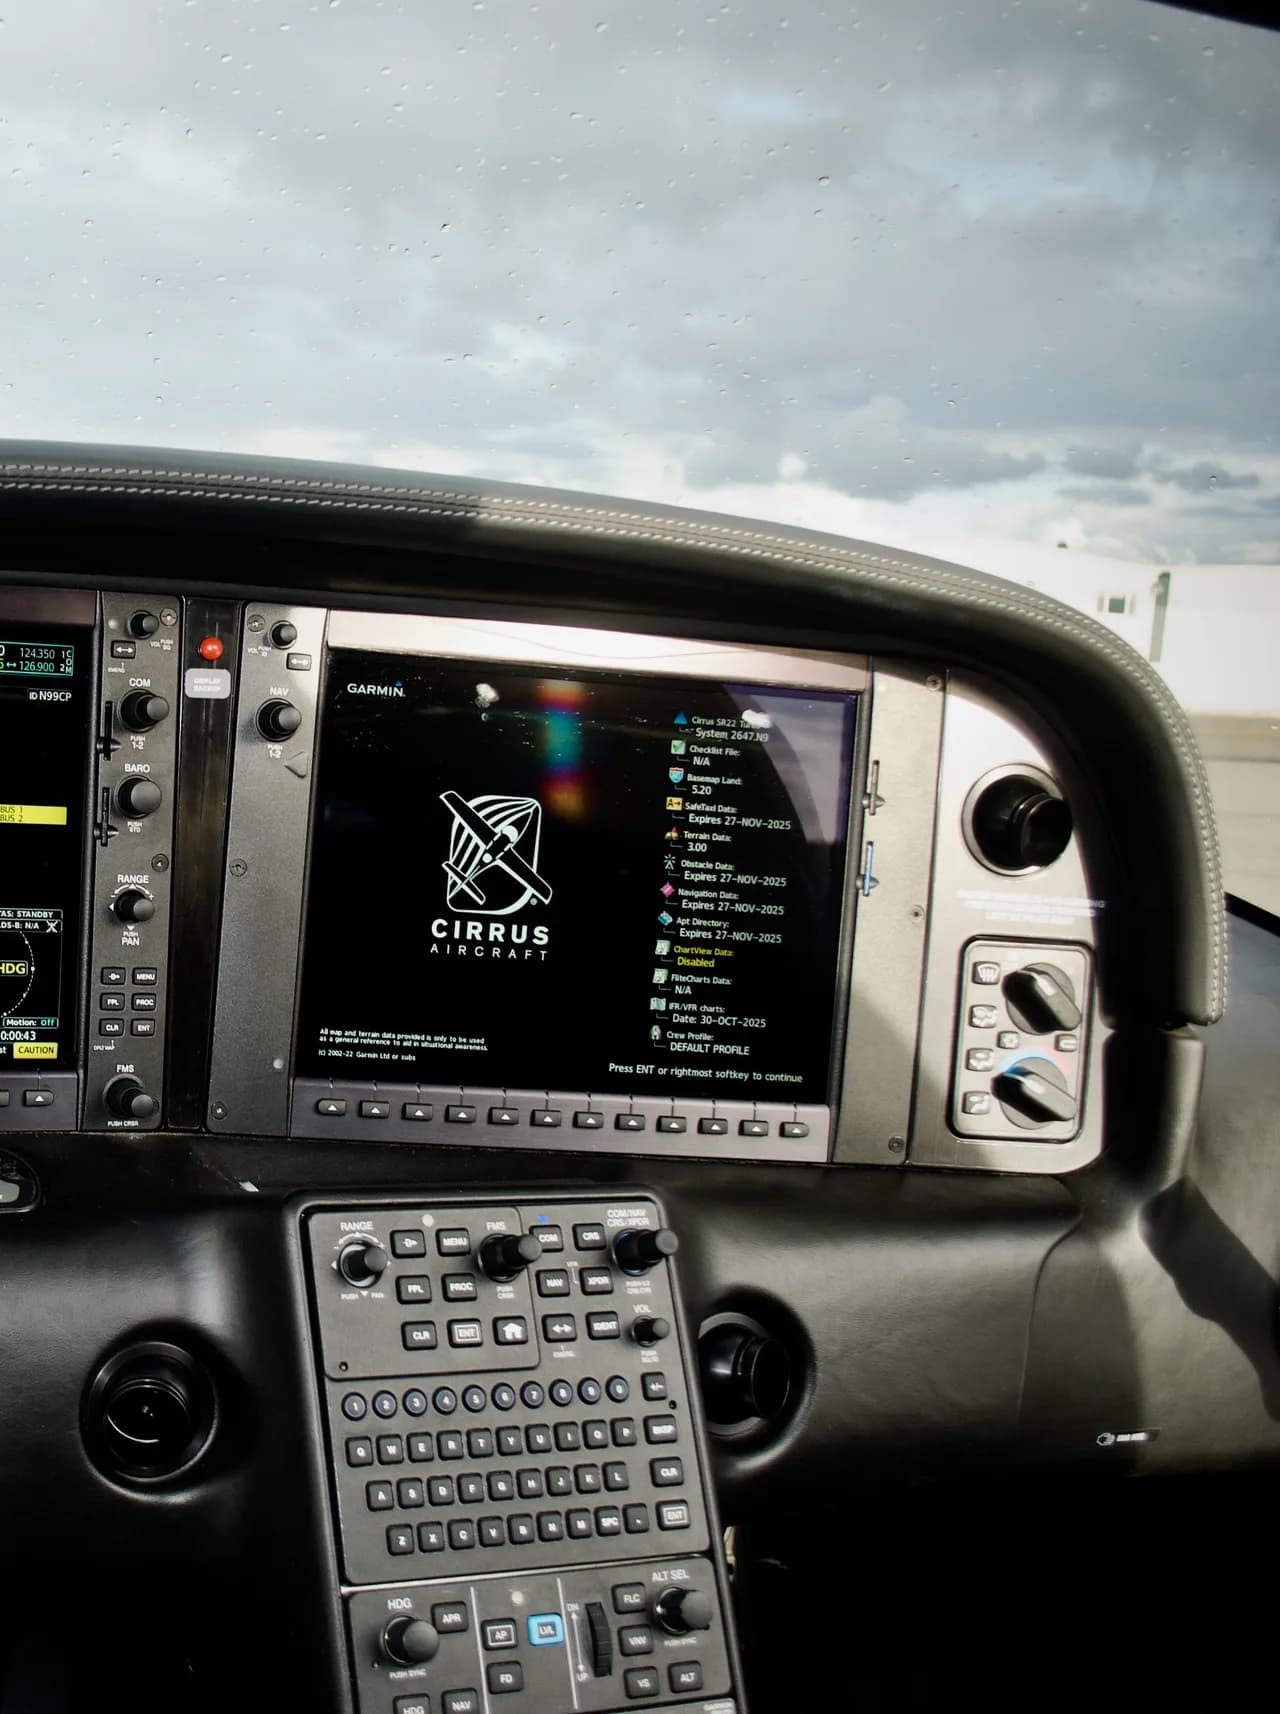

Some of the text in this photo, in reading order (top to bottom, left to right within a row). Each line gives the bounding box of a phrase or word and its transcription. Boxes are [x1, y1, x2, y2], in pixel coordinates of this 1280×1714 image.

[20, 648, 55, 659] 124.350
[20, 661, 54, 672] 126.900
[129, 678, 151, 687] COM
[39, 690, 72, 701] N99CP
[125, 764, 150, 773] BARO
[689, 814, 791, 830] Expires 27-NOV-2025
[117, 875, 149, 884] RANGE
[431, 919, 549, 945] CIRRUS
[122, 937, 140, 946] PAN
[430, 944, 547, 961] AIRCRAFT
[677, 957, 715, 967] Disabled
[673, 1014, 766, 1028] Date: 30-OCT-2025
[1, 1031, 36, 1041] 0:00:43
[18, 1046, 54, 1054] CAUTION
[670, 1043, 750, 1055] DEFAULT PROFILE
[116, 1065, 135, 1073] FMS
[609, 1063, 633, 1073] Press
[636, 1065, 655, 1074] ENT
[670, 1067, 712, 1078] rightmost
[716, 1069, 749, 1081] softkey
[753, 1072, 762, 1080] to
[765, 1073, 803, 1082] continue
[340, 1221, 373, 1231] RANGE
[486, 1221, 506, 1230] FMS
[652, 1569, 690, 1582] ALT SEL
[388, 1598, 412, 1610] HDG
[442, 1614, 461, 1623] APR
